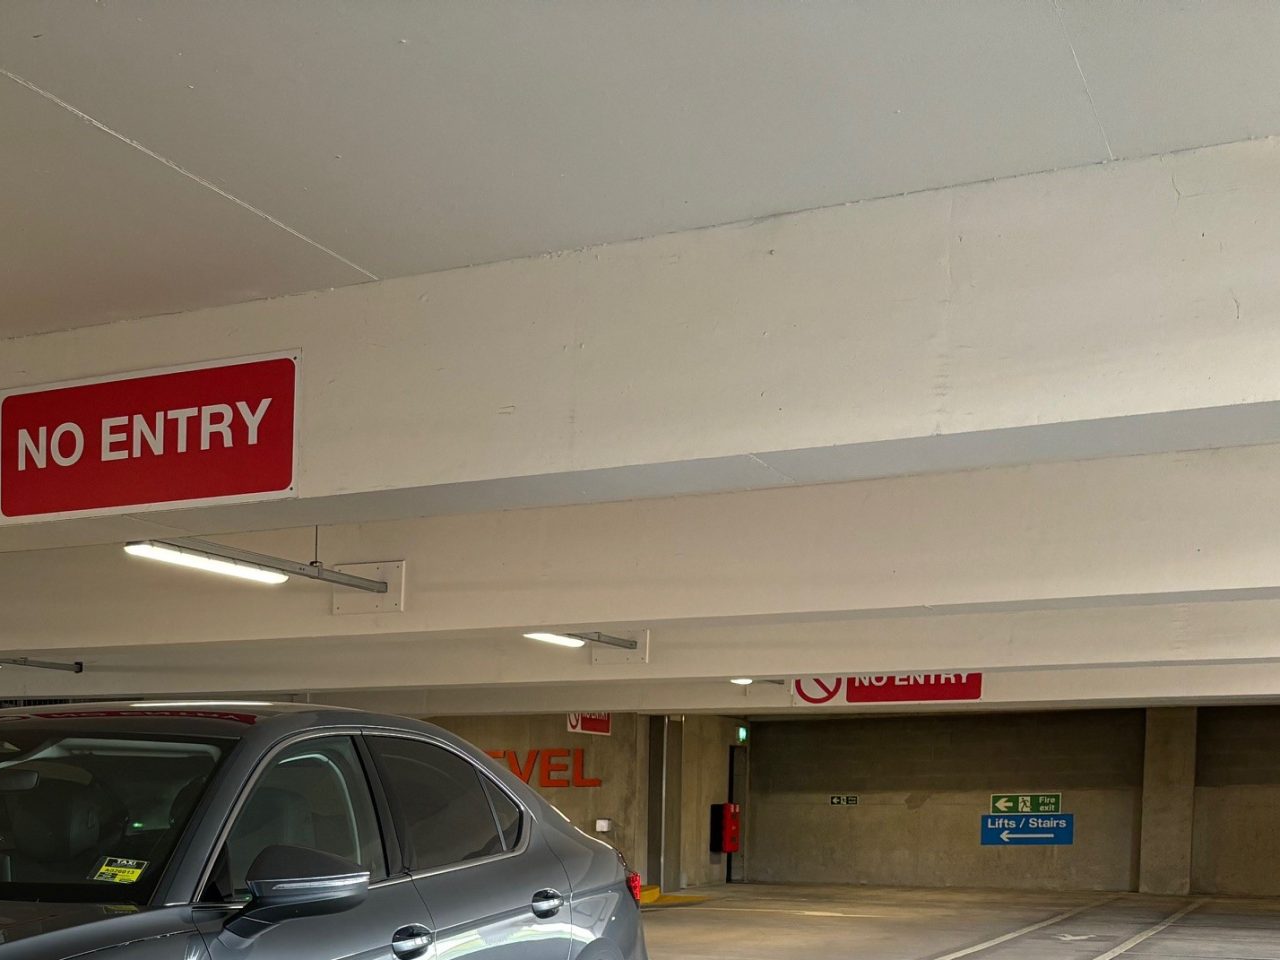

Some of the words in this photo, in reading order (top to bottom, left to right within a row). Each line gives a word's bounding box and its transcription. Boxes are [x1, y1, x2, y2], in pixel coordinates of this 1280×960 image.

[17, 422, 85, 472] NO
[100, 397, 273, 462] ENTRY
[1039, 796, 1056, 804] Fire
[1039, 804, 1055, 812] exit
[987, 818, 1016, 828] Lifts
[1019, 818, 1026, 828] /
[1028, 817, 1067, 828] Stairs
